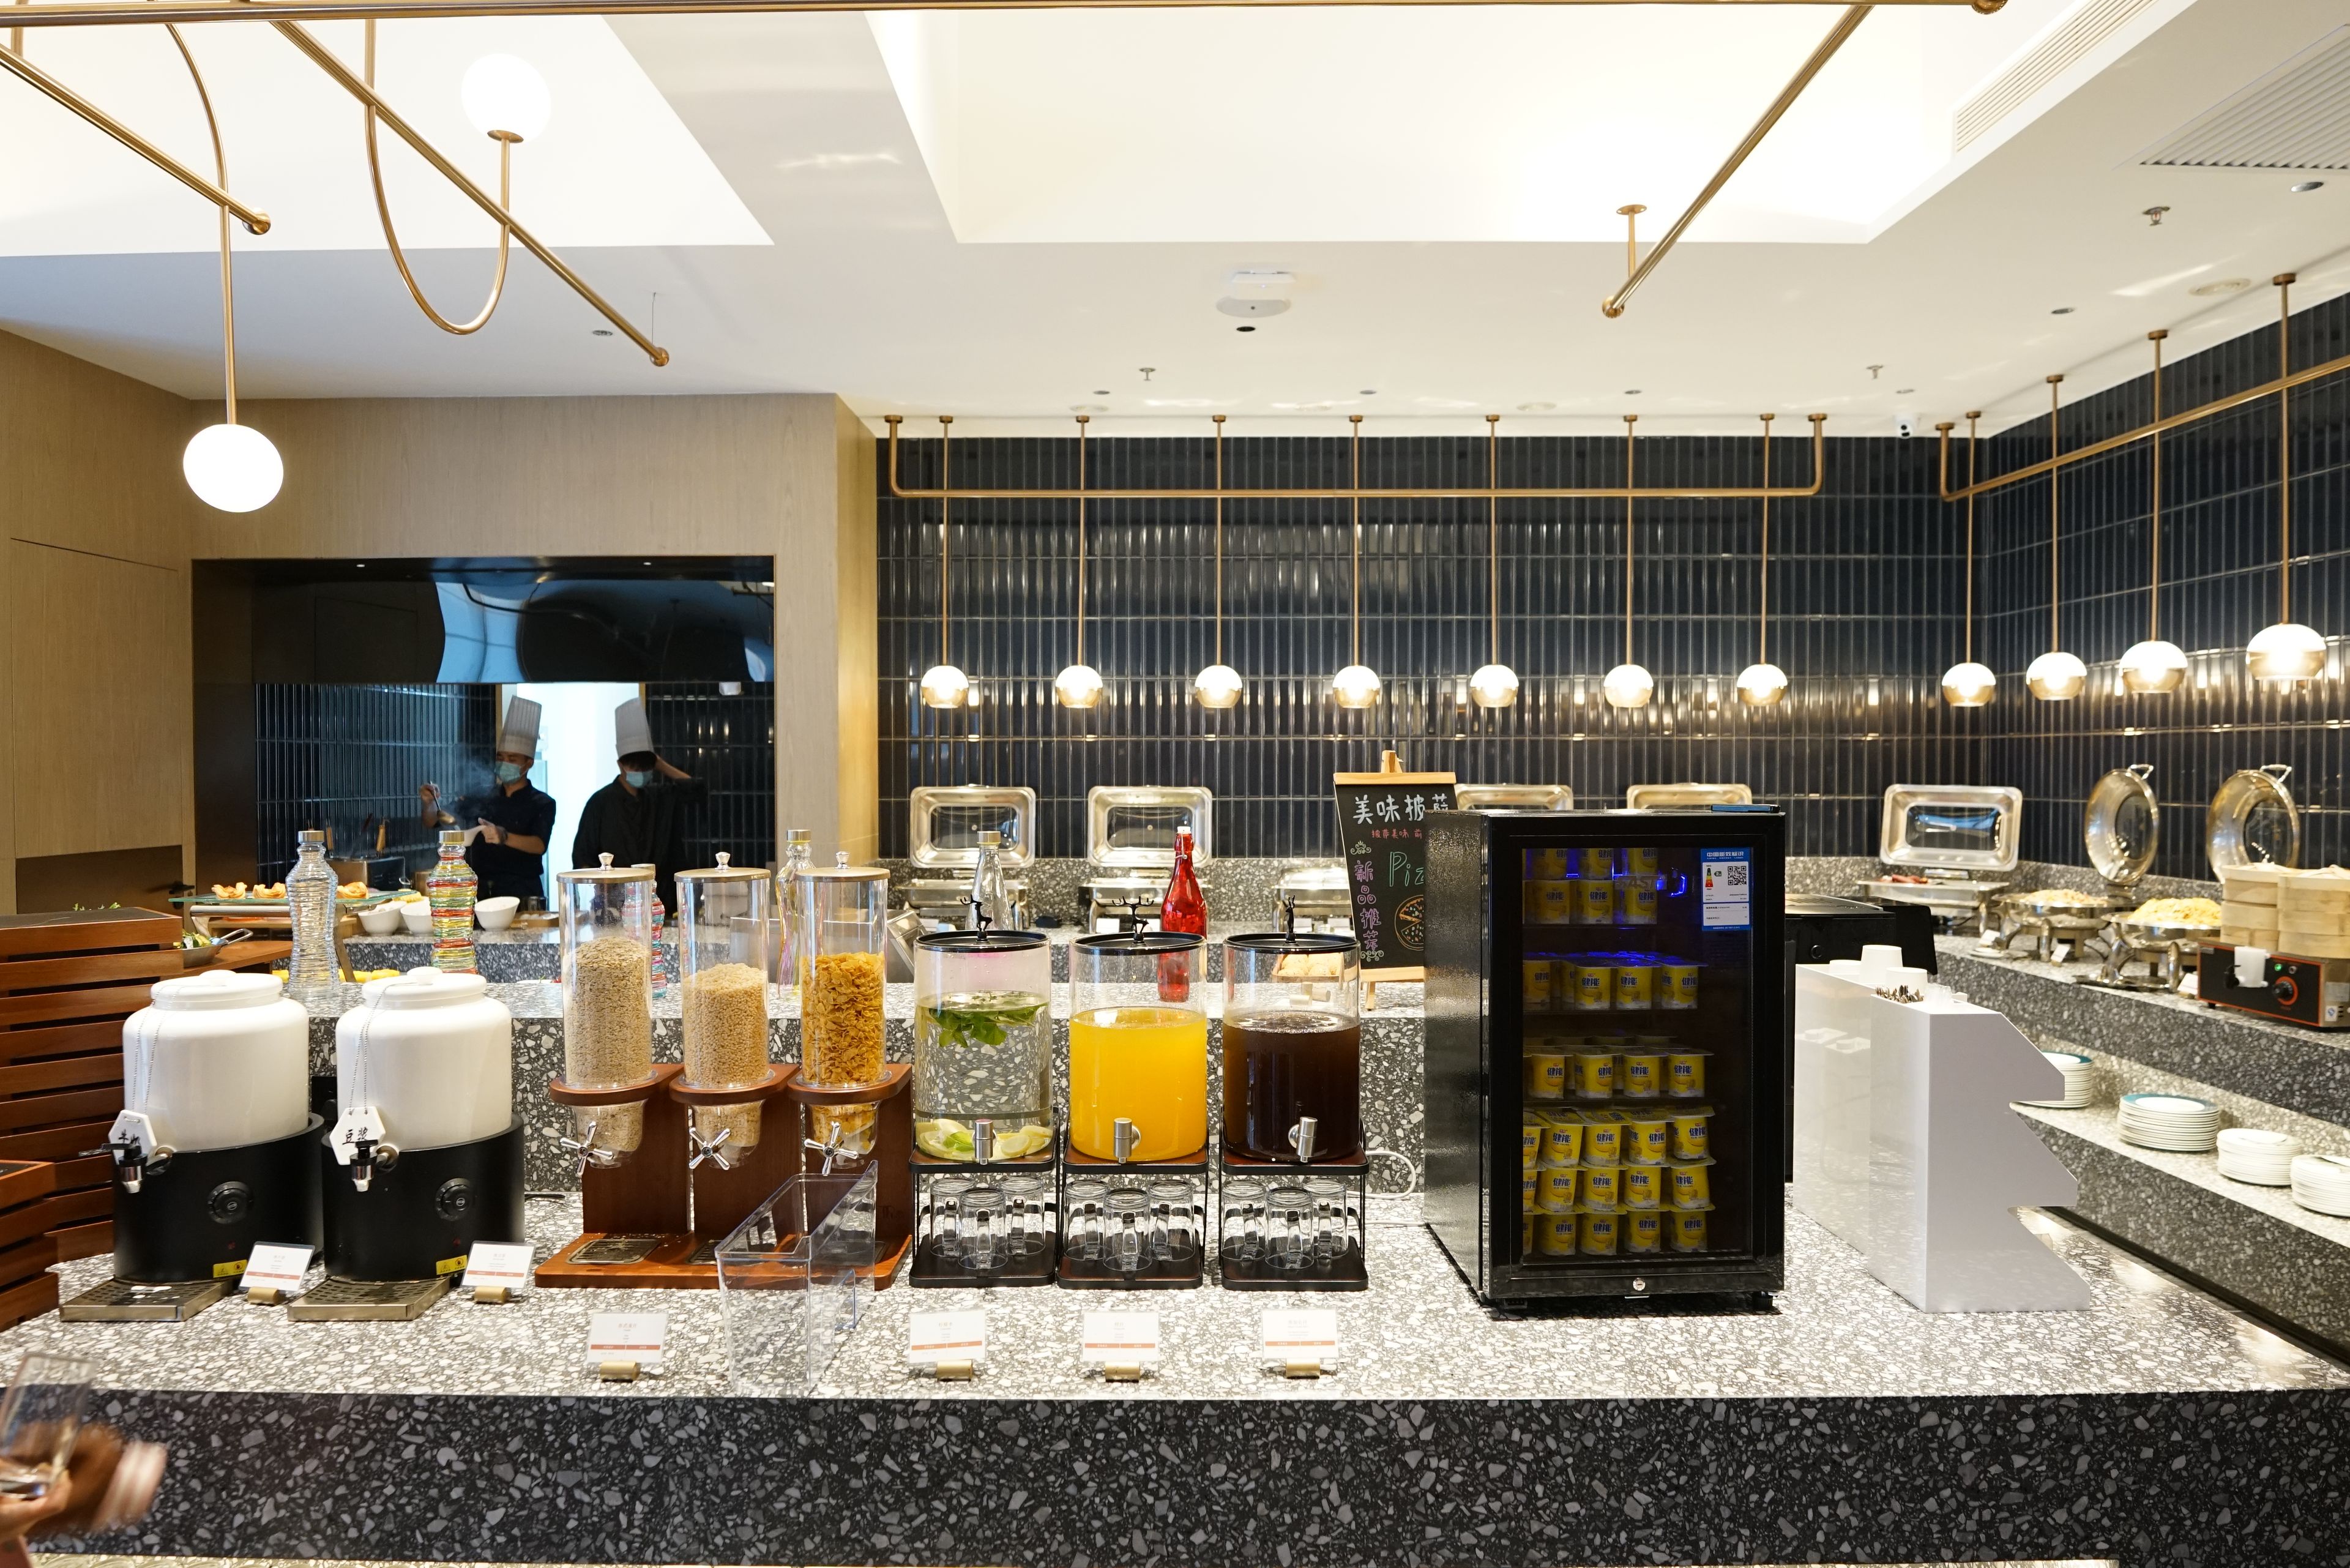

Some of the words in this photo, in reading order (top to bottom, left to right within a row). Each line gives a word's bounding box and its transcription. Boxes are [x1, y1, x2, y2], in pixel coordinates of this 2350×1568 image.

[1354, 860, 1382, 950] 新品推荐
[1631, 1067, 1649, 1075] 健能
[1674, 1066, 1692, 1074] 健能
[1553, 1133, 1571, 1143] 健能
[1596, 1133, 1614, 1142] 健能
[1553, 1178, 1571, 1186] 健能
[1593, 1177, 1611, 1185] 健能
[1630, 1175, 1649, 1184] 健能
[1676, 1175, 1693, 1185] 健能
